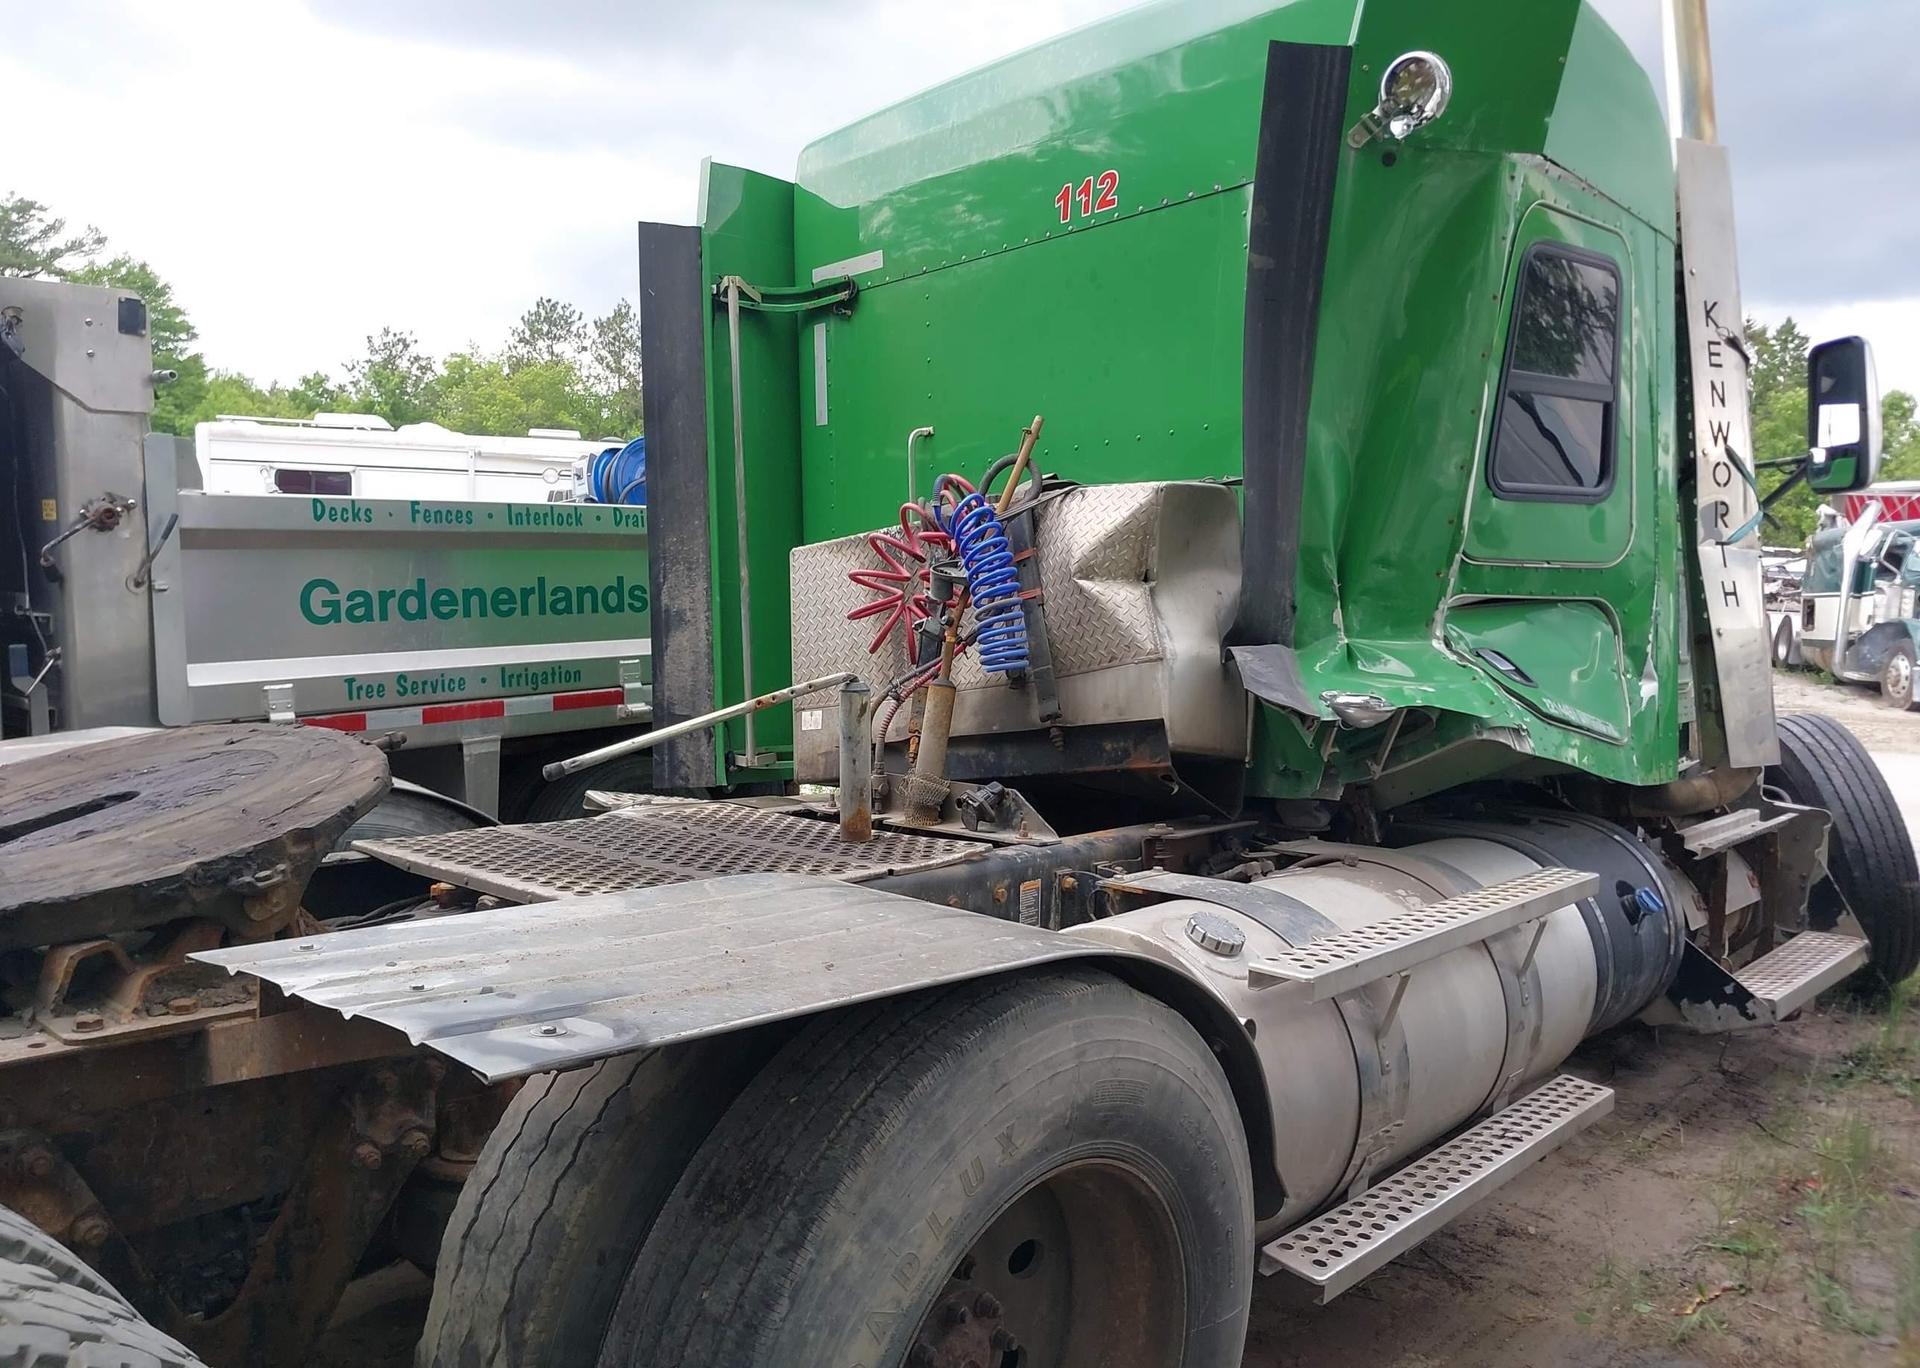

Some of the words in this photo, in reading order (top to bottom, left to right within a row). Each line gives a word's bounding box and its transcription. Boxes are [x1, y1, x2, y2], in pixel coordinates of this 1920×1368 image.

[1055, 169, 1120, 224] 112
[1703, 300, 1740, 608] KENWORTH
[312, 497, 373, 524] Decks
[410, 500, 473, 525] Fences
[507, 503, 584, 528] Interlock
[613, 507, 645, 528] Drai
[300, 575, 649, 626] Gardenerlands
[344, 677, 386, 701] Tree
[396, 673, 467, 698] Service
[501, 665, 583, 691] Irrigation
[849, 1121, 1027, 1368] ADLUX
